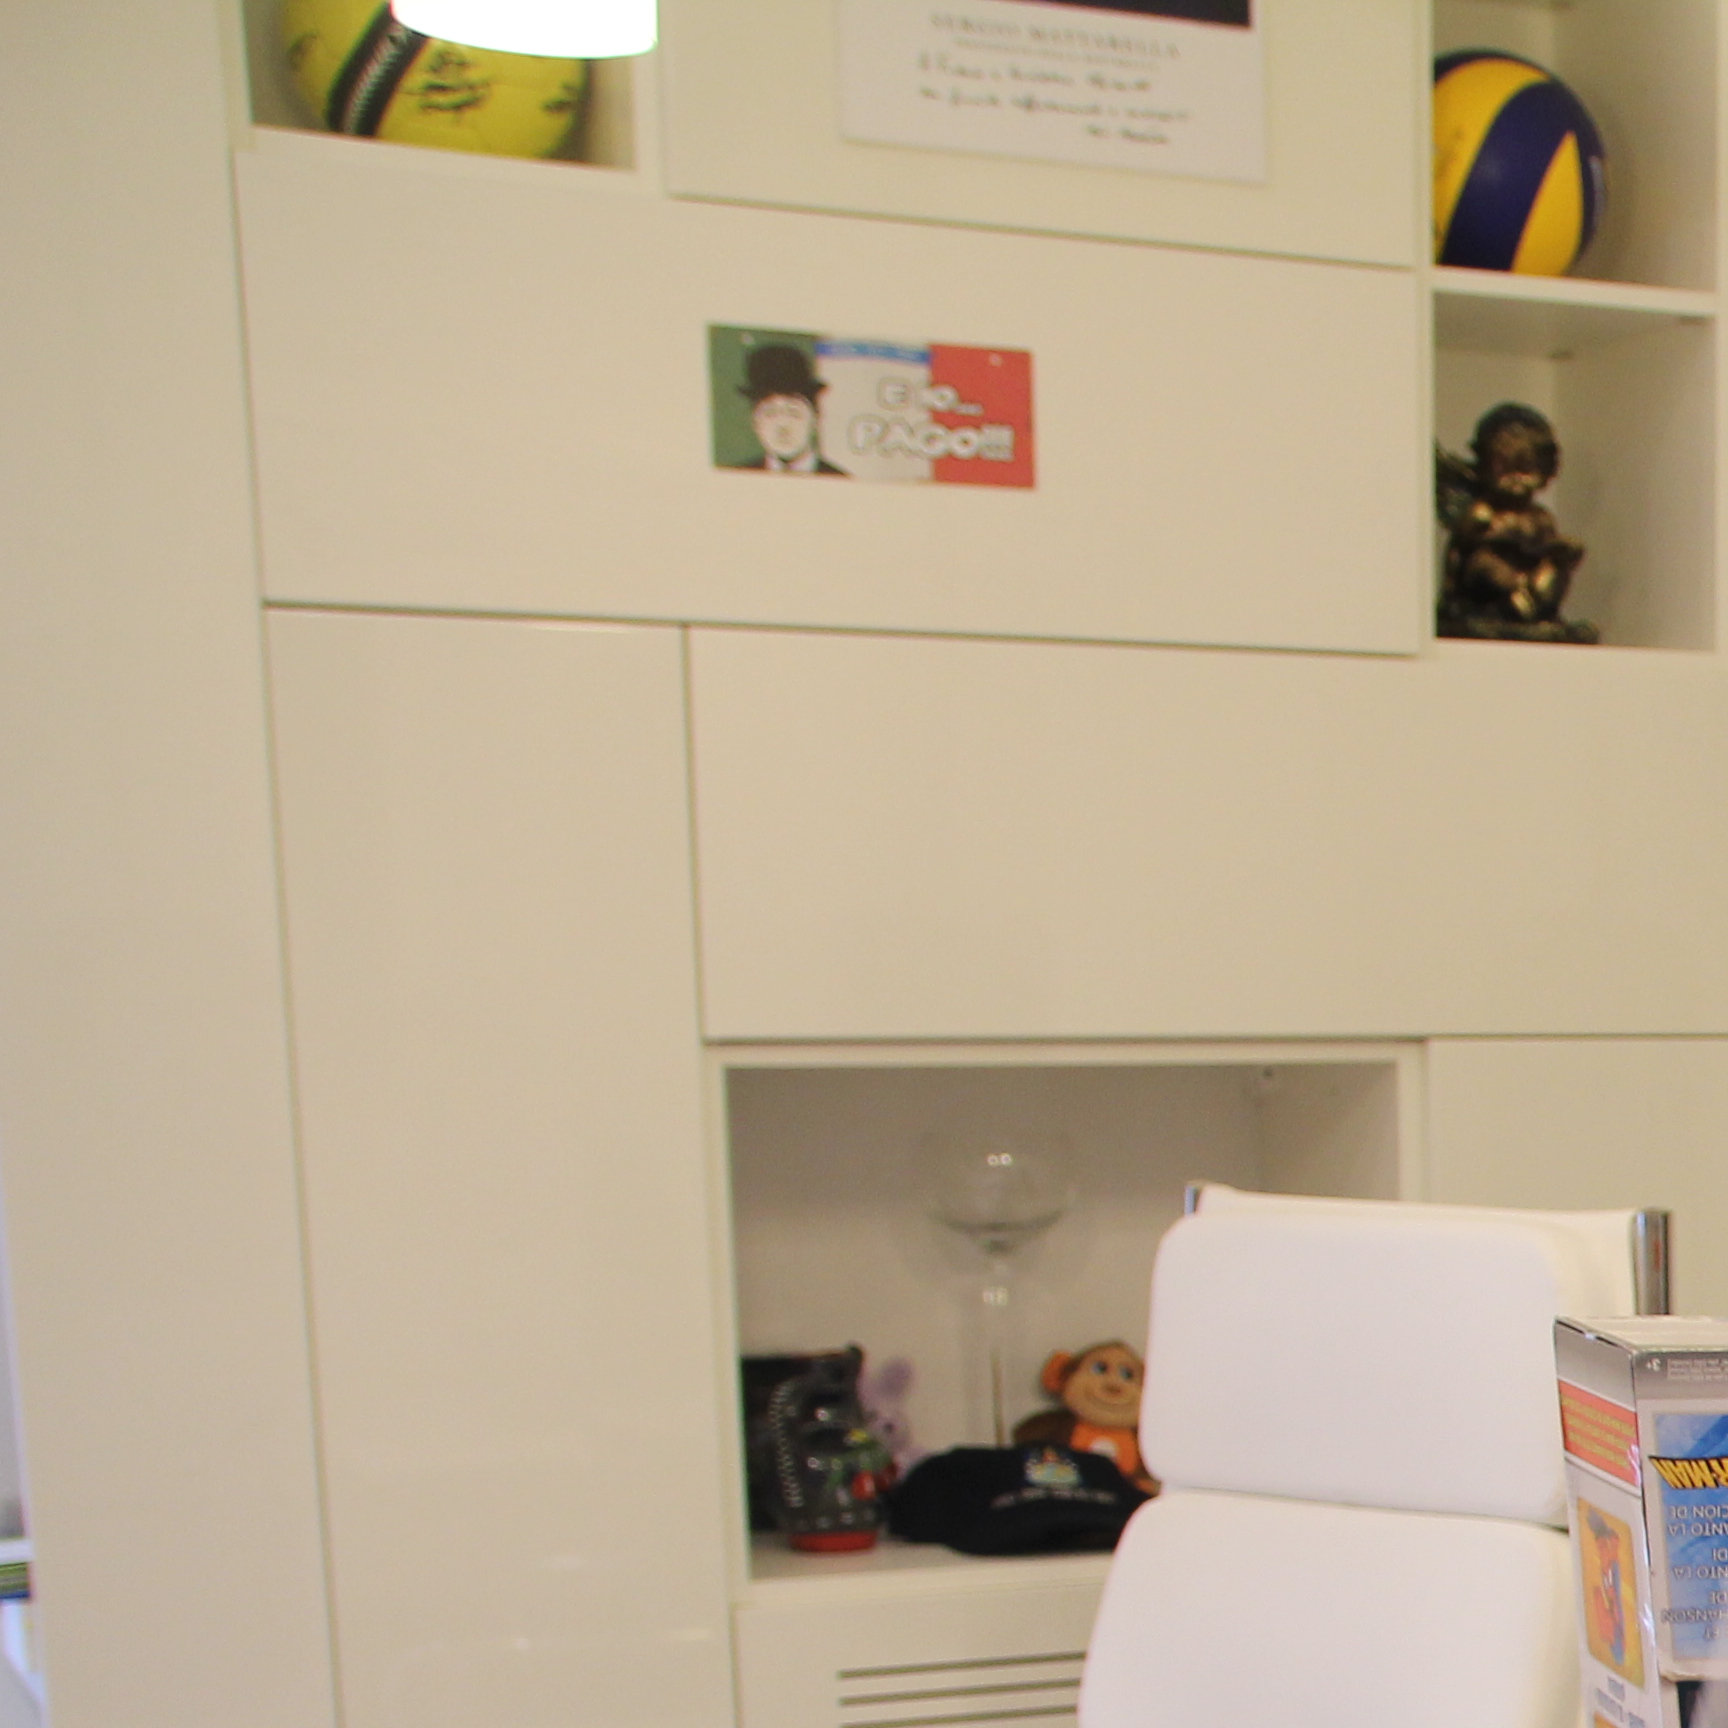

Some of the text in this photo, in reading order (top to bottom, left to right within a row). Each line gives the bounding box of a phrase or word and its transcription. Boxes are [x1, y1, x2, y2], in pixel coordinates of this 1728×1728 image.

[1670, 1506, 1687, 1518] DE
[1667, 1524, 1685, 1535] LA
[1712, 1549, 1728, 1561] DI
[1673, 1566, 1692, 1579] LA
